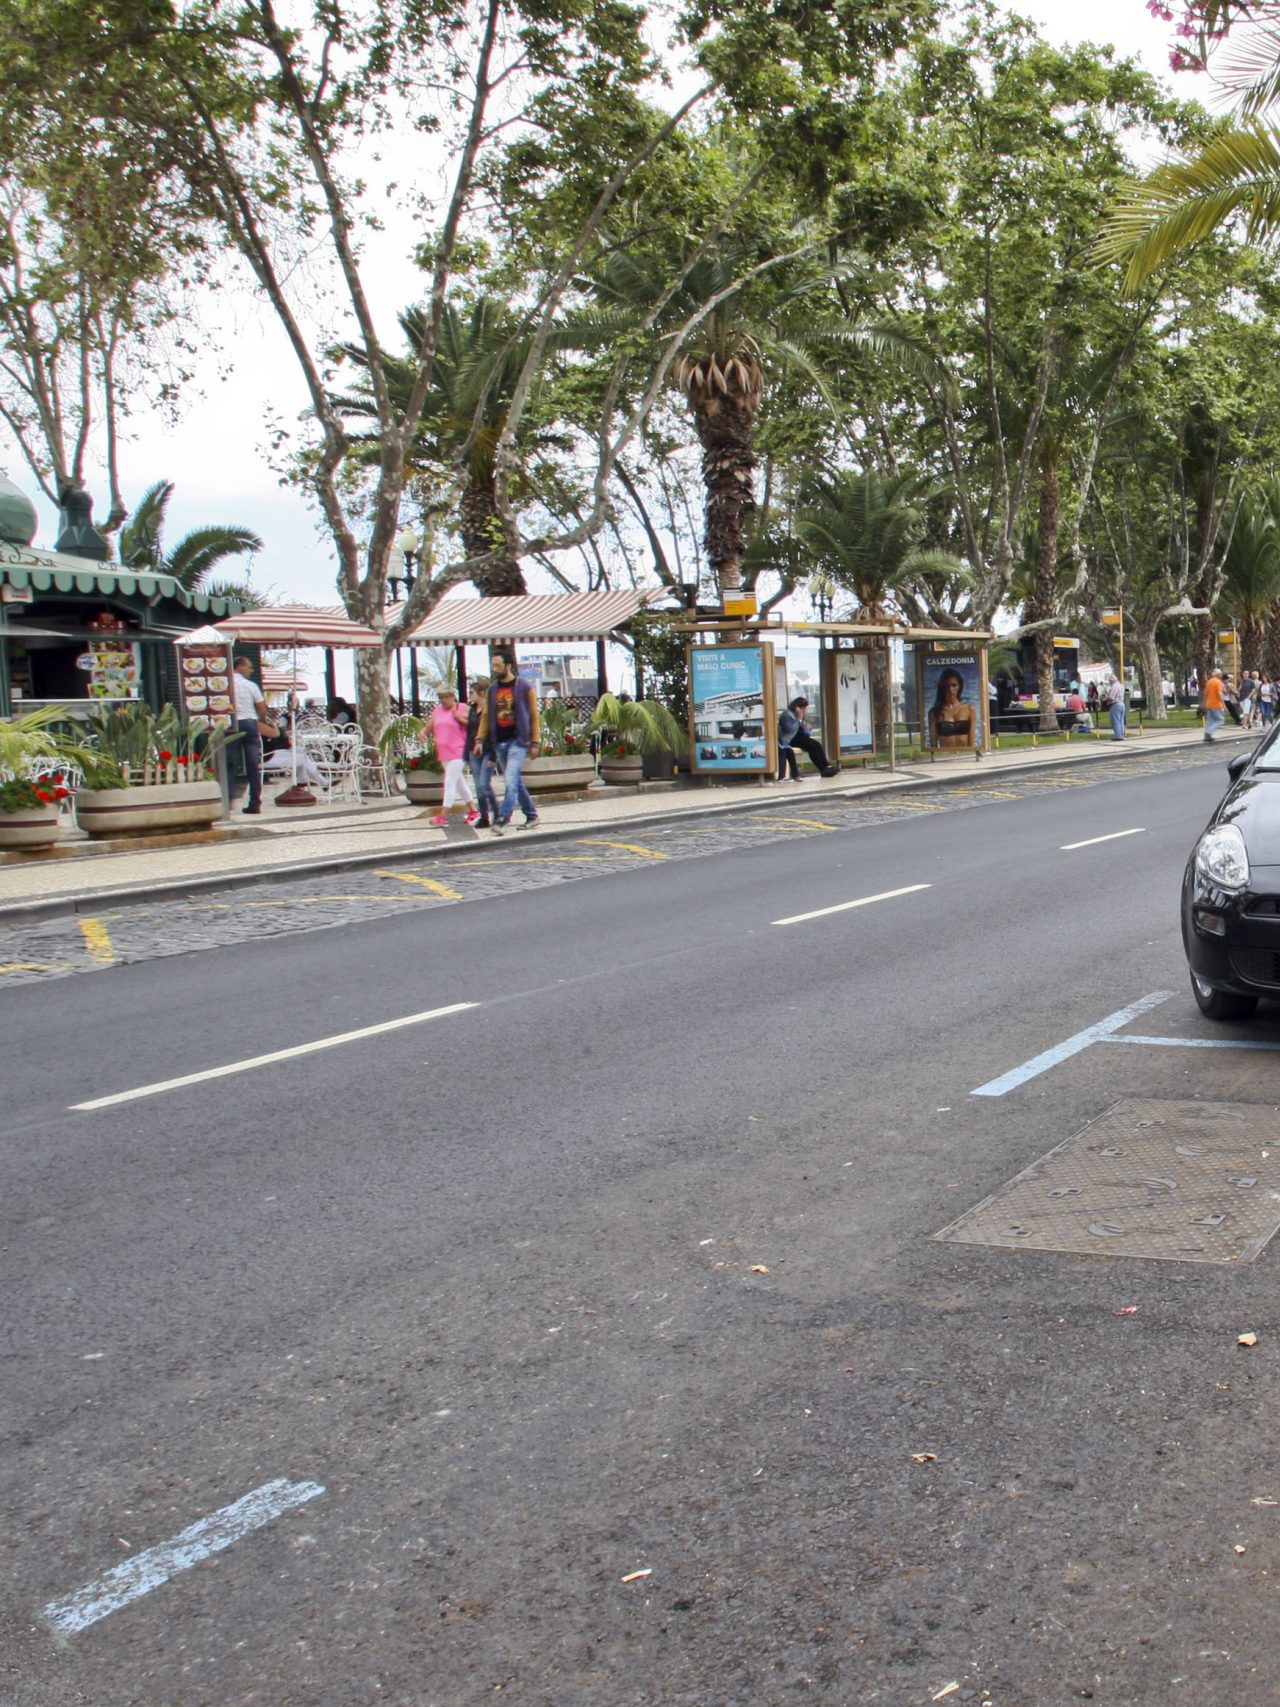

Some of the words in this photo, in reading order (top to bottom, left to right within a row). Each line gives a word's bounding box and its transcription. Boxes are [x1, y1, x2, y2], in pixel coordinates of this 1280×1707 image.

[697, 654, 719, 662] VISITE
[720, 653, 726, 661] A
[926, 657, 975, 665] CALZEDONIA
